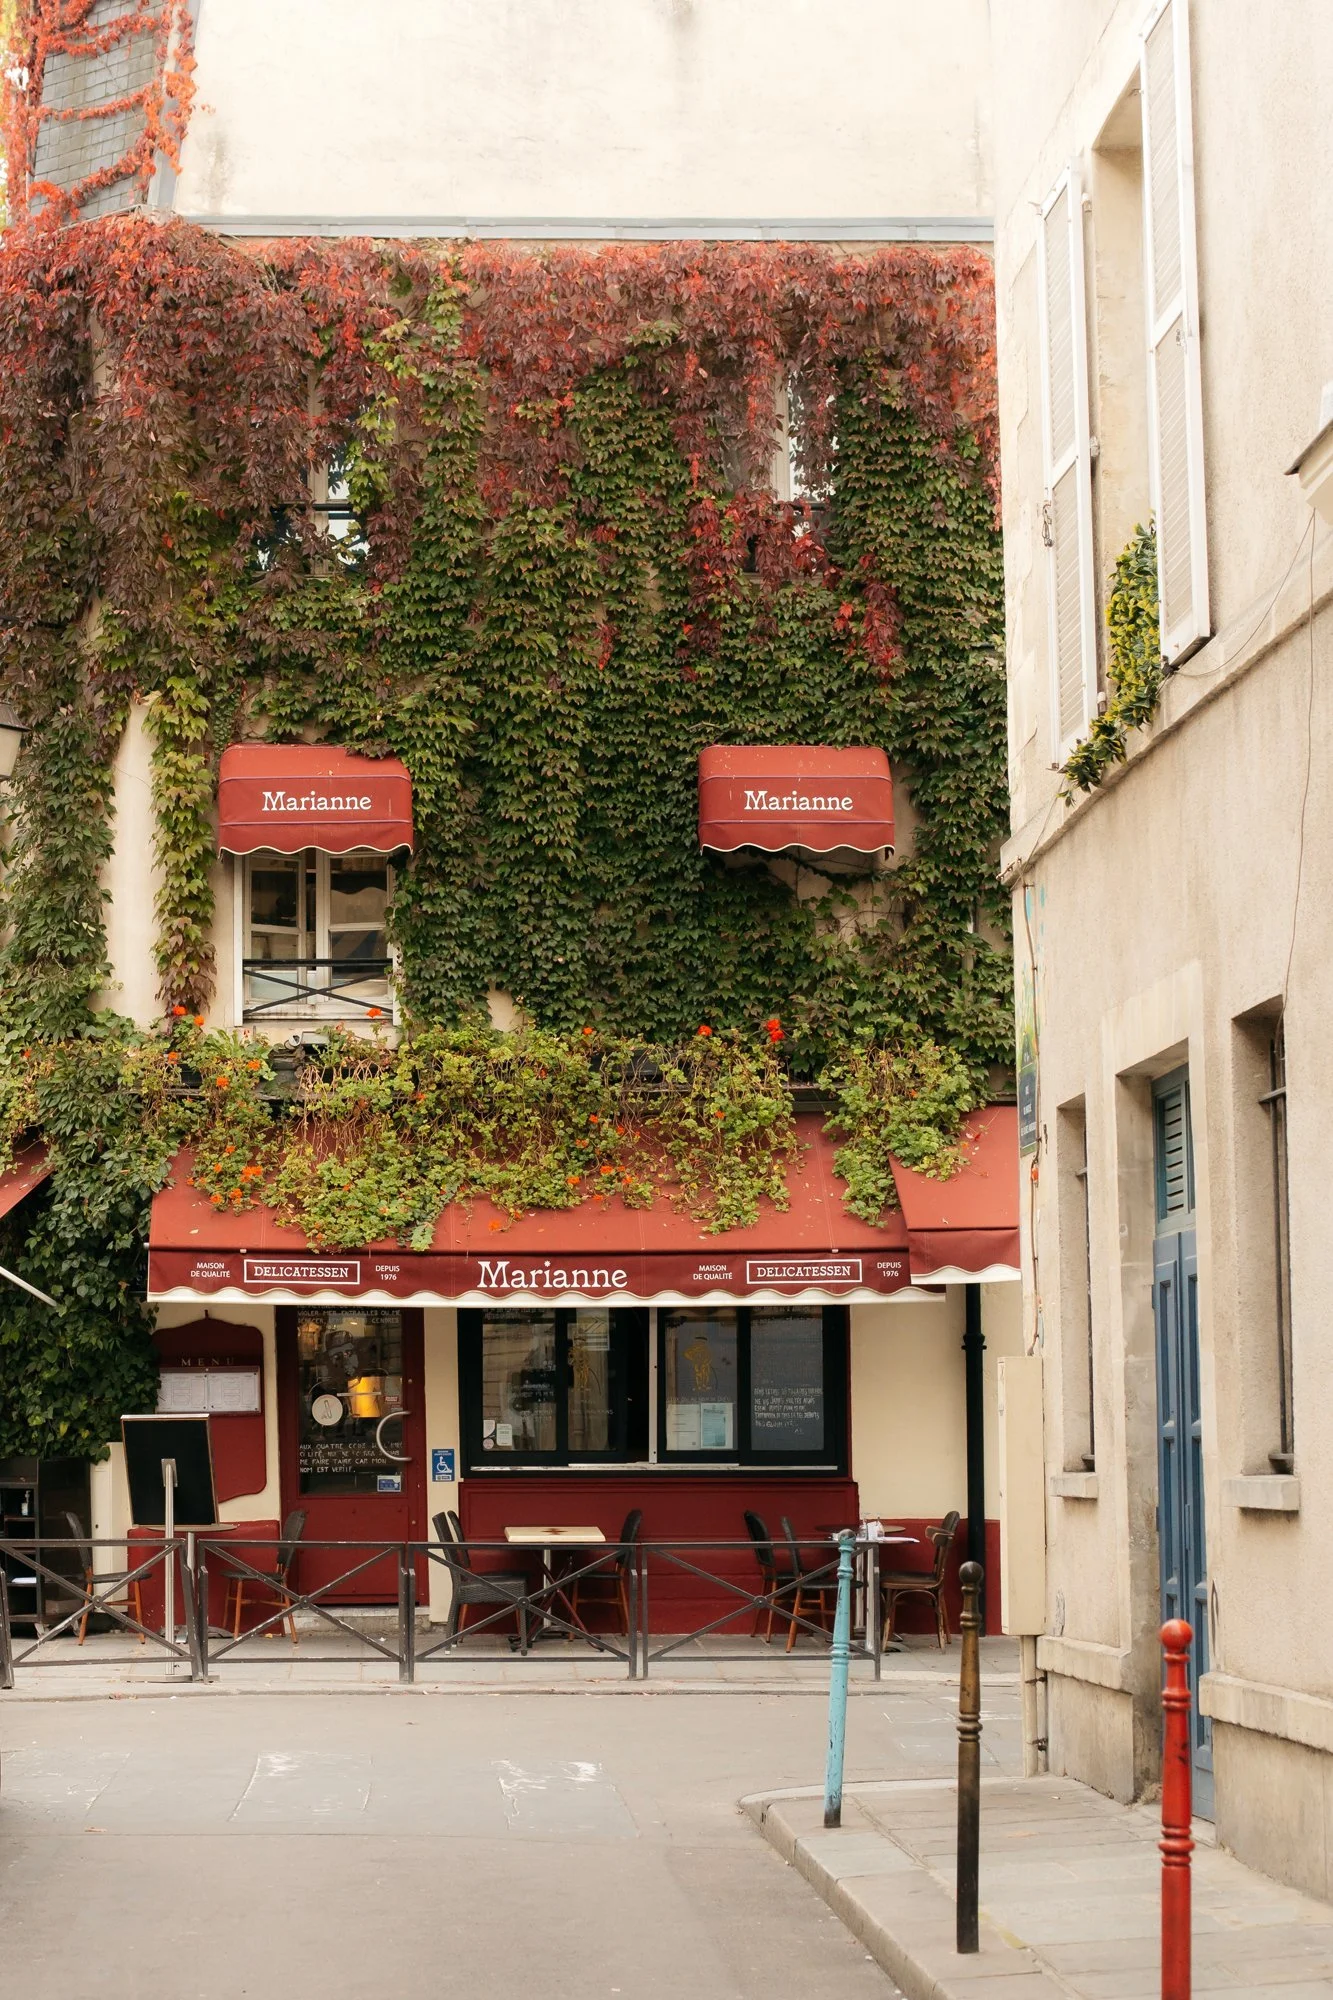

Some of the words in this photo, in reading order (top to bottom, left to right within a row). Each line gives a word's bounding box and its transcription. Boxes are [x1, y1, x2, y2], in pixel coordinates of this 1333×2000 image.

[262, 790, 372, 811] Marianne
[744, 790, 854, 811] Marianne
[375, 1265, 400, 1273] DEPUIS
[699, 1264, 727, 1272] MAISON
[877, 1261, 902, 1269] DEPUIS
[190, 1270, 200, 1278] DE
[201, 1270, 231, 1278] QUALITÉ
[254, 1265, 349, 1278] DELICATESSEN
[477, 1260, 628, 1288] Marianne
[757, 1265, 851, 1278] DELICATESSEN
[381, 1273, 397, 1281] 1976
[703, 1272, 733, 1280] QUALITÉ
[181, 1357, 234, 1366] MENU
